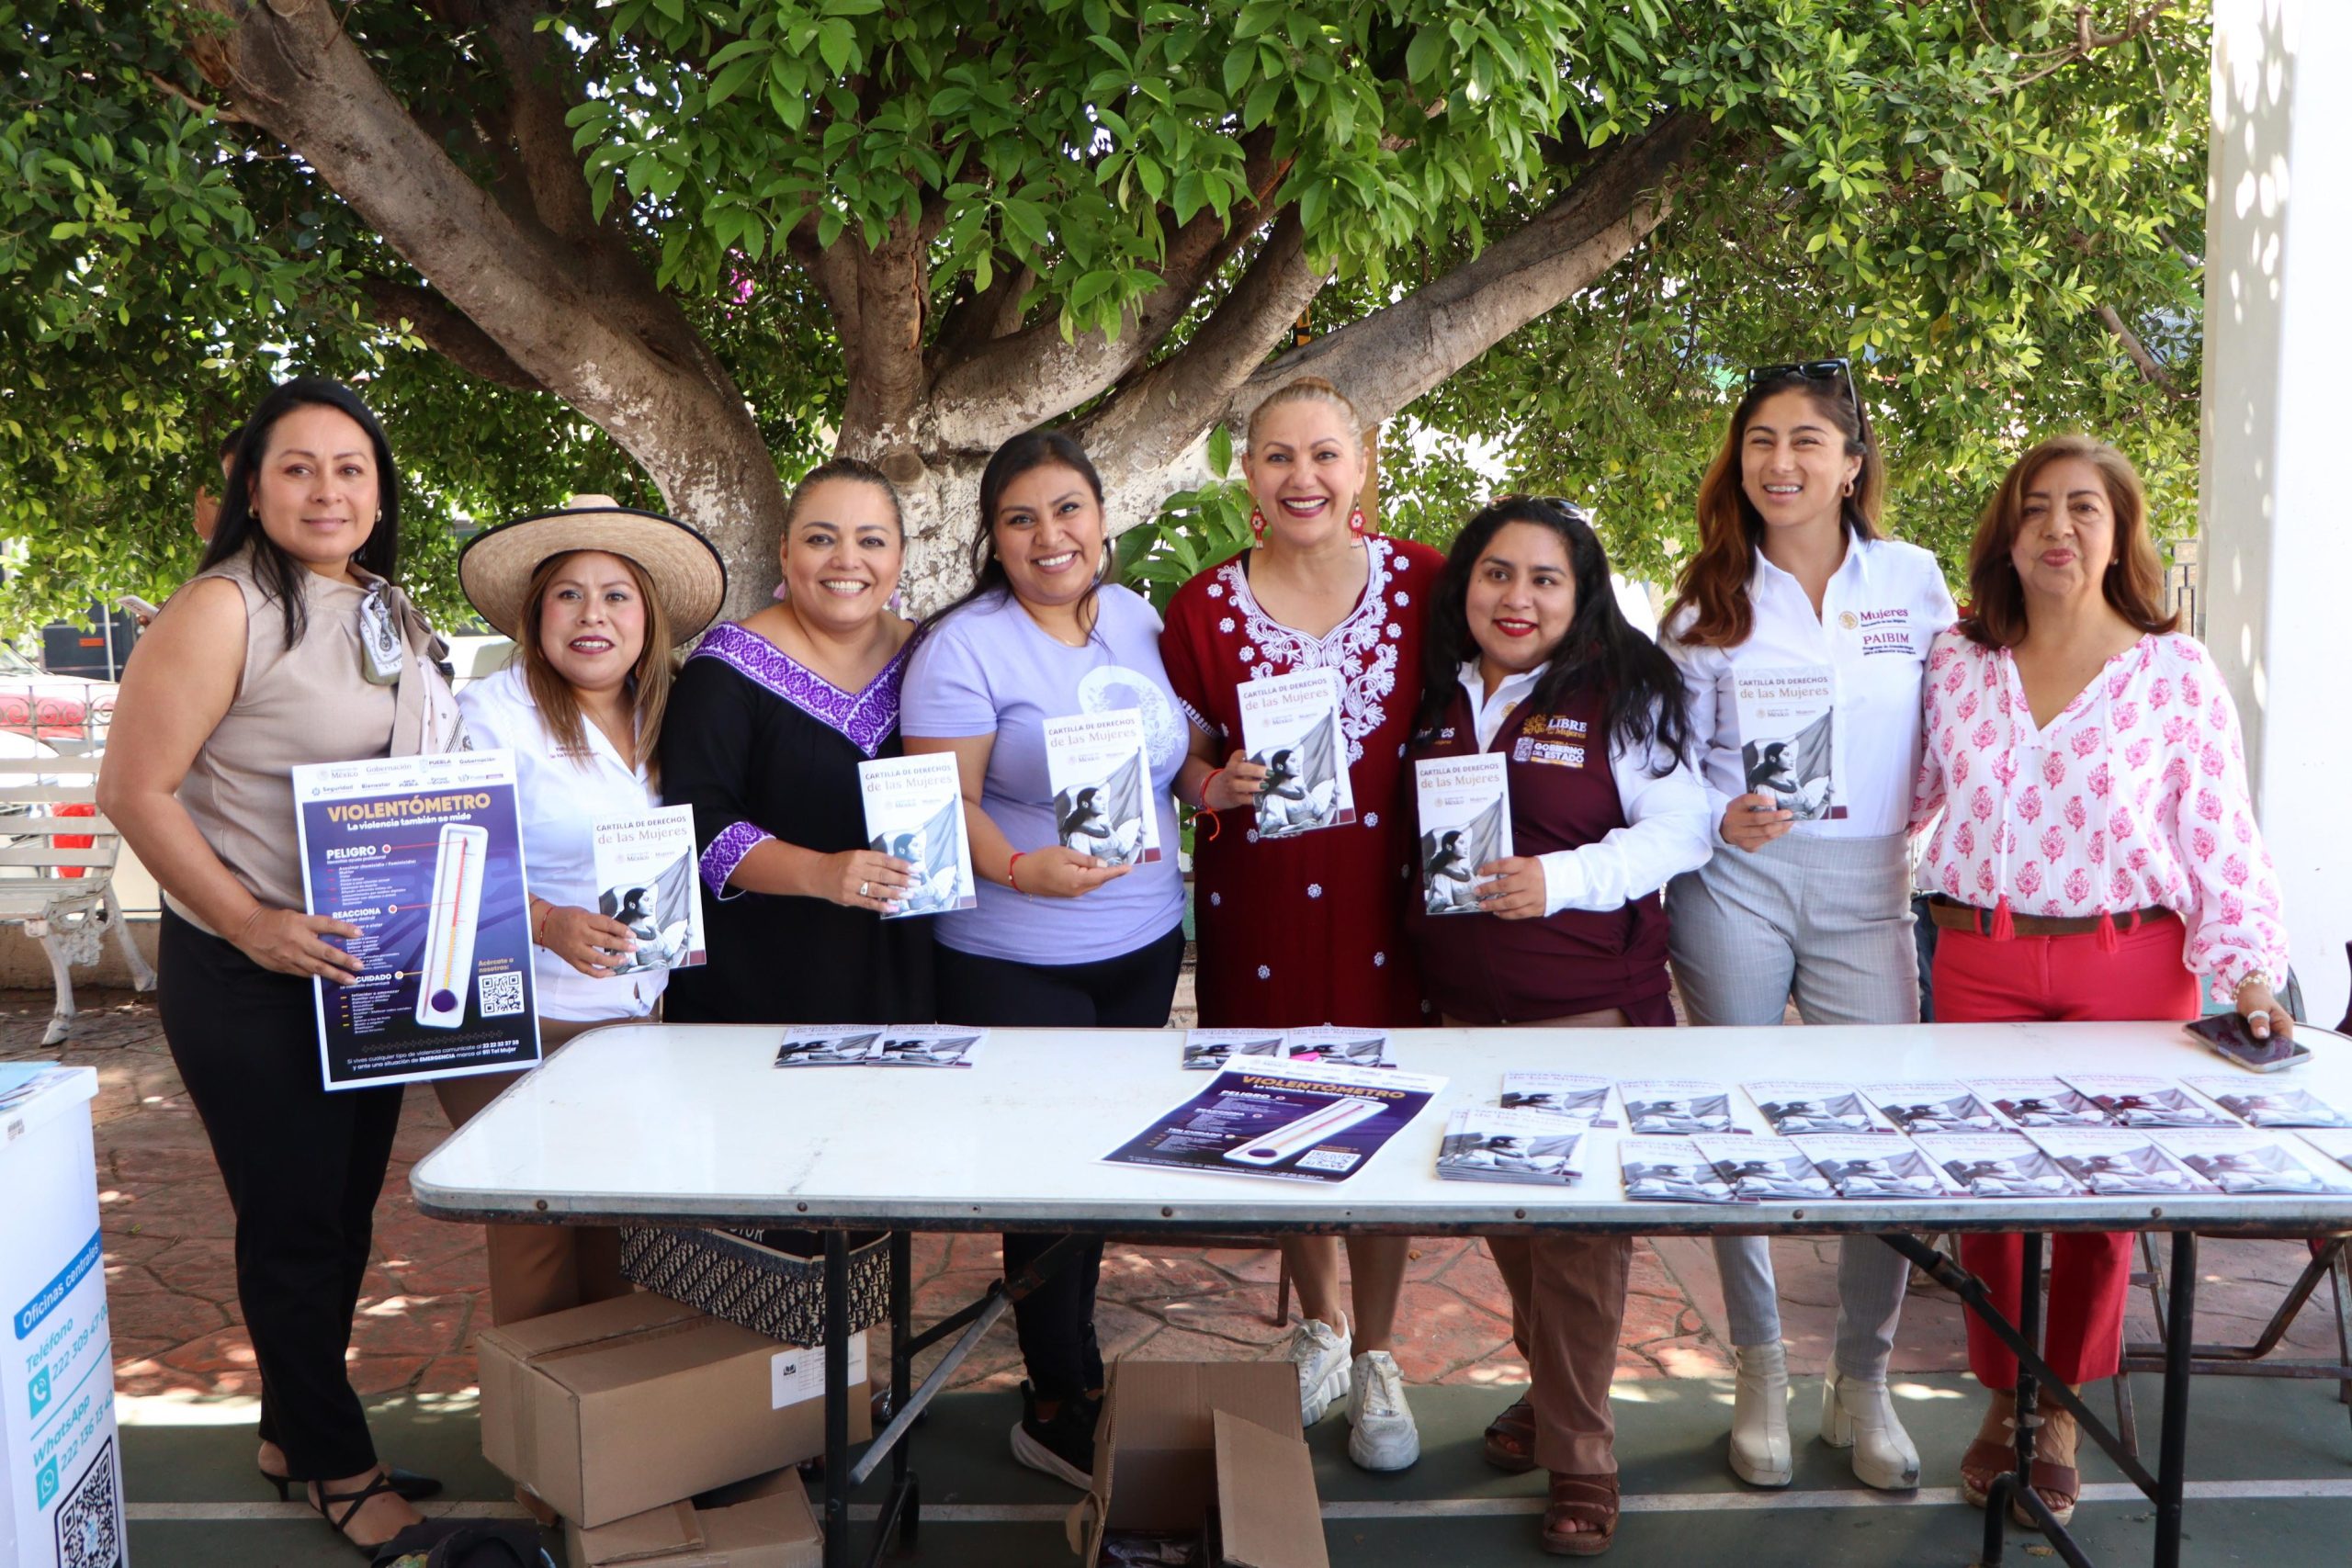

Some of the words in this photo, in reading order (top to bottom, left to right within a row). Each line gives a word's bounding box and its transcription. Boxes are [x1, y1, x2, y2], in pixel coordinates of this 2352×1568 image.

[1860, 608, 1908, 621] Mujeres
[1863, 632, 1909, 645] PAIBIM
[1788, 676, 1828, 684] DERECHOS
[1244, 688, 1277, 698] CARTILLA
[1290, 678, 1327, 689] DERECHOS
[1740, 688, 1754, 698] de
[1758, 688, 1775, 698] las
[1779, 687, 1828, 699] Mujeres
[1245, 700, 1259, 711] de
[1262, 698, 1279, 707] las
[1282, 689, 1329, 704] Mujeres
[1048, 725, 1084, 735] CARTILLA
[1097, 718, 1136, 728] DERECHOS
[1548, 718, 1588, 733] LIBRE
[1050, 737, 1064, 748] de
[1068, 735, 1086, 745] las
[1089, 728, 1136, 742] Mujeres
[1534, 742, 1584, 755] GOBIERNO
[1544, 751, 1584, 763] ESTADO
[331, 770, 359, 779] México
[366, 763, 412, 773] Gobernación
[865, 770, 900, 780] CARTILLA
[913, 765, 951, 773] DERECHOS
[1419, 768, 1452, 776] CARTILLA
[1463, 762, 1499, 772] DERECHOS
[867, 781, 882, 792] de
[886, 780, 902, 790] las
[906, 775, 953, 788] Mujeres
[1420, 779, 1433, 788] de
[1437, 777, 1452, 787] las
[1455, 773, 1499, 786] Mujeres
[322, 784, 353, 793] Seguridad
[327, 793, 491, 823] VIOLENTÓMETRO
[347, 823, 358, 831] La
[359, 818, 399, 830] violencia
[401, 814, 437, 826] también
[449, 812, 471, 821] mide
[596, 823, 634, 832] CARTILLA
[647, 816, 686, 826] DERECHOS
[597, 834, 613, 844] de
[617, 832, 635, 843] las
[639, 827, 687, 841] Mujeres
[327, 845, 377, 860] PELIGRO
[333, 908, 382, 919] REACCIONA
[356, 974, 391, 983] CUIDADO
[368, 1054, 395, 1064] cualquier
[417, 1048, 441, 1056] violencia
[384, 1058, 410, 1066] situación
[419, 1054, 456, 1062] EMERGENCIA
[1220, 1089, 1271, 1099] PELIGRO
[1242, 1075, 1406, 1099] VIOLENTÓMETRO
[22, 1282, 64, 1329] Oficinas
[65, 1242, 99, 1288] centrales
[26, 1317, 74, 1373] Teléfono
[52, 1350, 70, 1382] 222
[72, 1329, 88, 1359] 309
[90, 1313, 99, 1334] 47
[33, 1394, 90, 1468] WhatsApp
[61, 1439, 78, 1472] 222
[81, 1418, 94, 1446] 136
